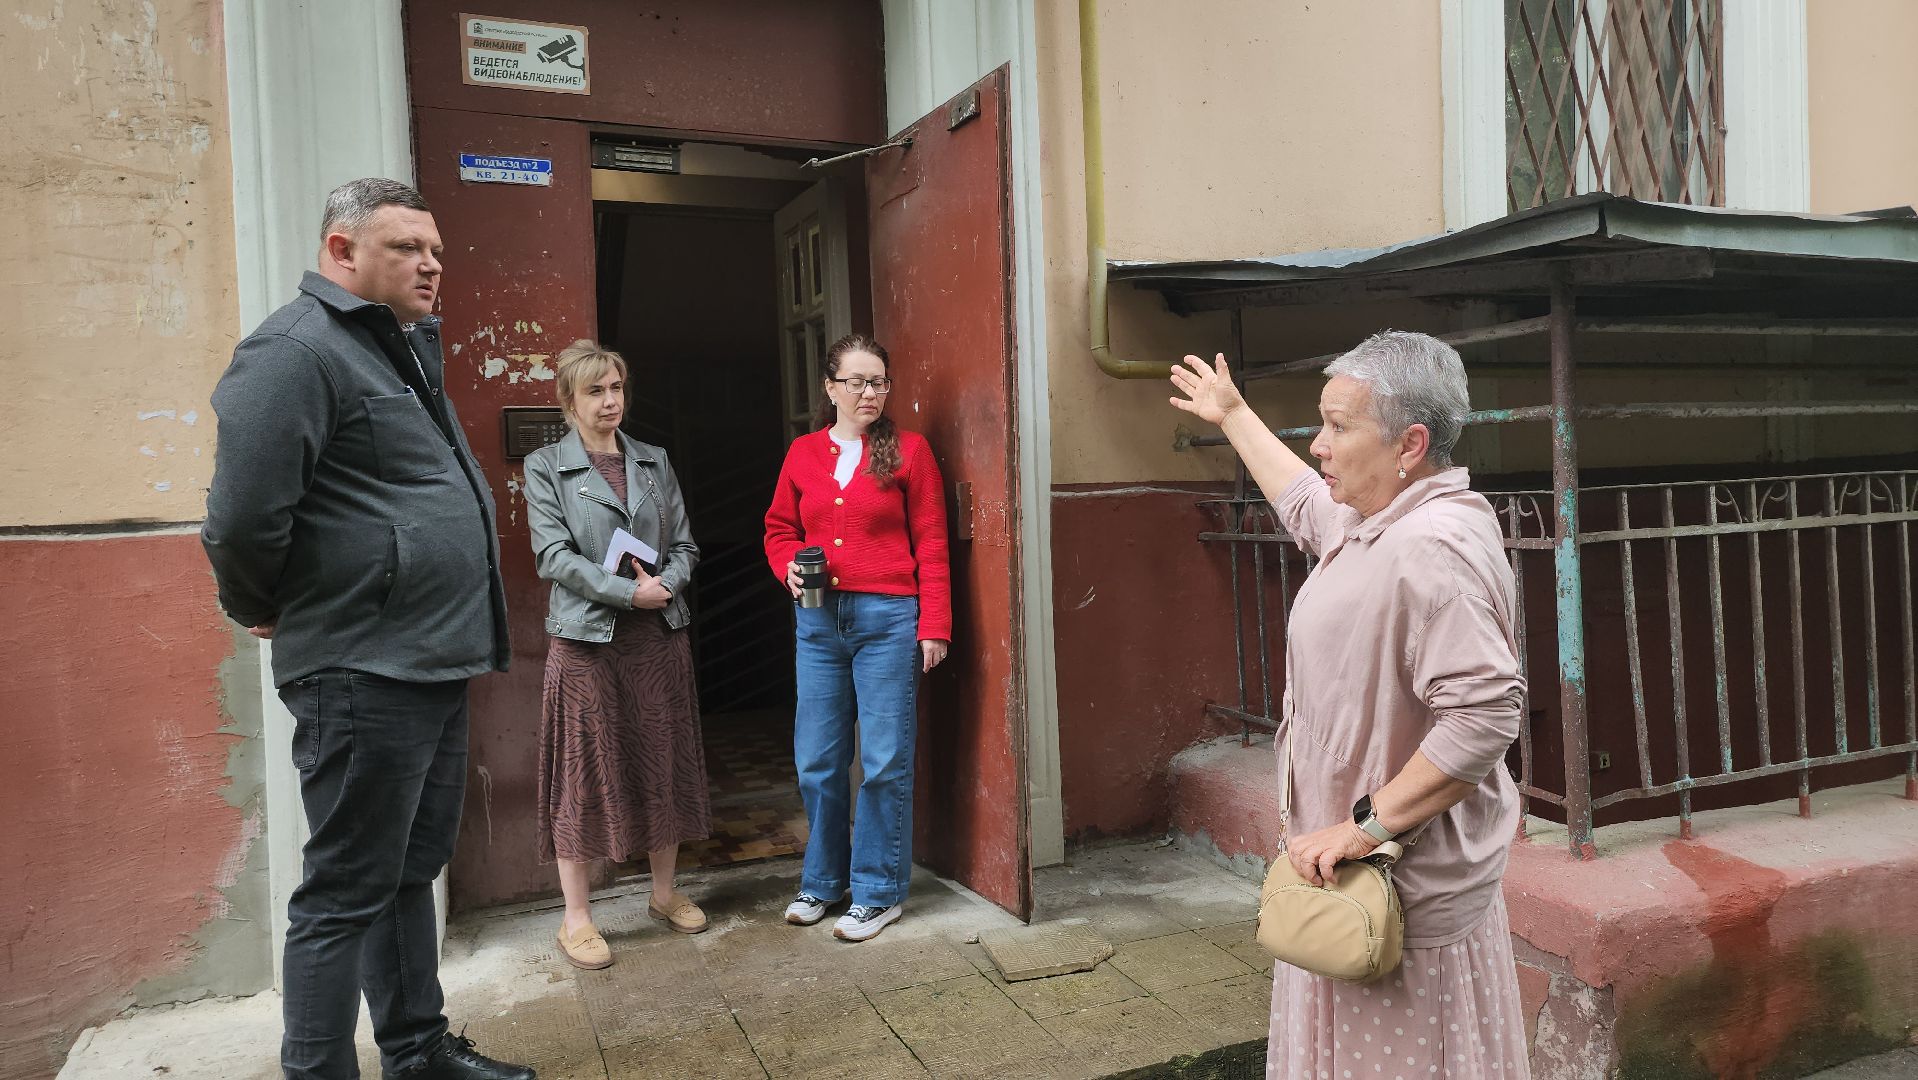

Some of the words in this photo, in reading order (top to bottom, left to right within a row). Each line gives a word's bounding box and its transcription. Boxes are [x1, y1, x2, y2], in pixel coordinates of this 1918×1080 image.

[473, 39, 524, 52] ВНИМАНИЕ
[473, 56, 519, 69] ВЕДЕТСЯ
[473, 68, 581, 86] ВИДЕОНАБЛЮДЕНИЕ!
[475, 158, 520, 169] ПОДЪЕЗД
[476, 171, 496, 179] КВ.
[501, 171, 539, 182] 21-40
